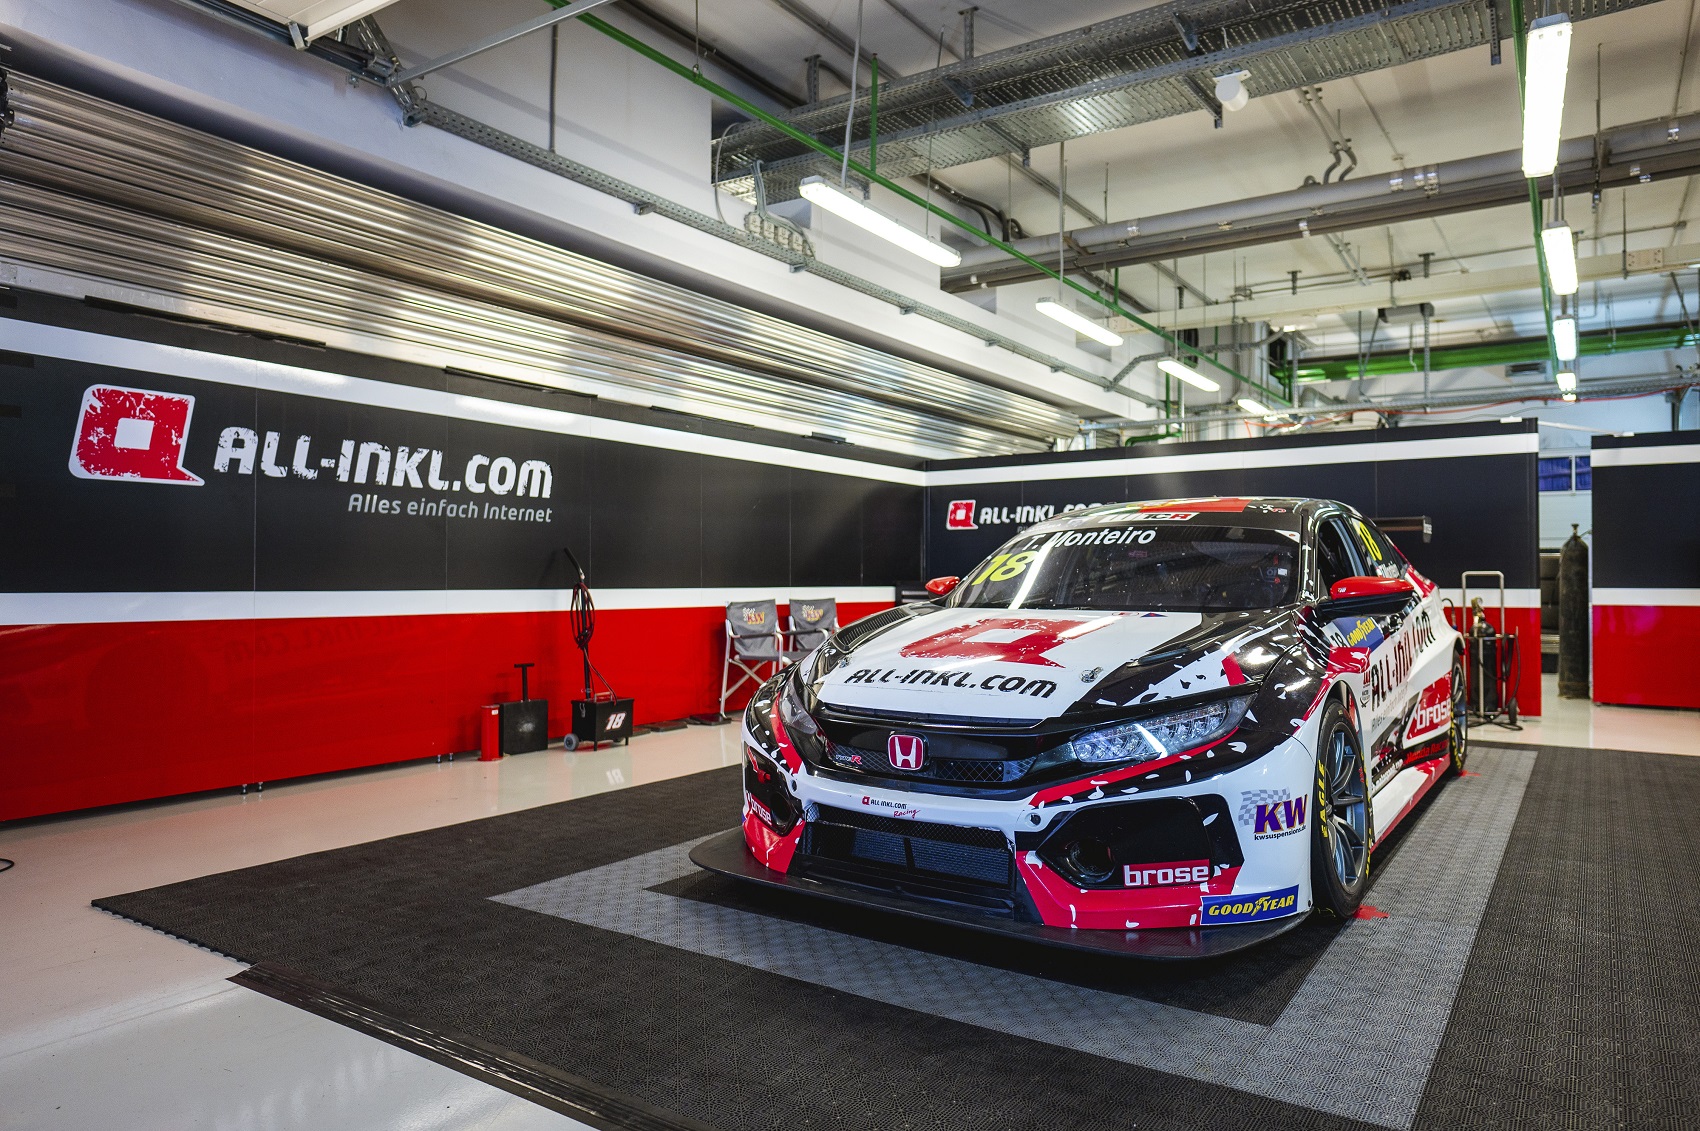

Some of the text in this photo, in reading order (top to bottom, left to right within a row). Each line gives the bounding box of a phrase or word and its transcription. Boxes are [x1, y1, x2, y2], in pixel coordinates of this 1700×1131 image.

[214, 427, 553, 499] ALL-INKL.COM
[348, 493, 553, 523] Alles einfach Internet
[1022, 534, 1046, 551] T.
[1043, 527, 1157, 549] Monteiro
[971, 550, 1039, 586] 18
[844, 668, 1058, 699] ALL-INKL.COM
[605, 712, 627, 731] 18
[850, 754, 862, 765] R
[1318, 759, 1329, 838] EAGLE
[893, 809, 921, 819] Racing
[1254, 793, 1308, 834] KW
[1123, 864, 1209, 886] brose
[1208, 895, 1295, 917] GOODYEAR
